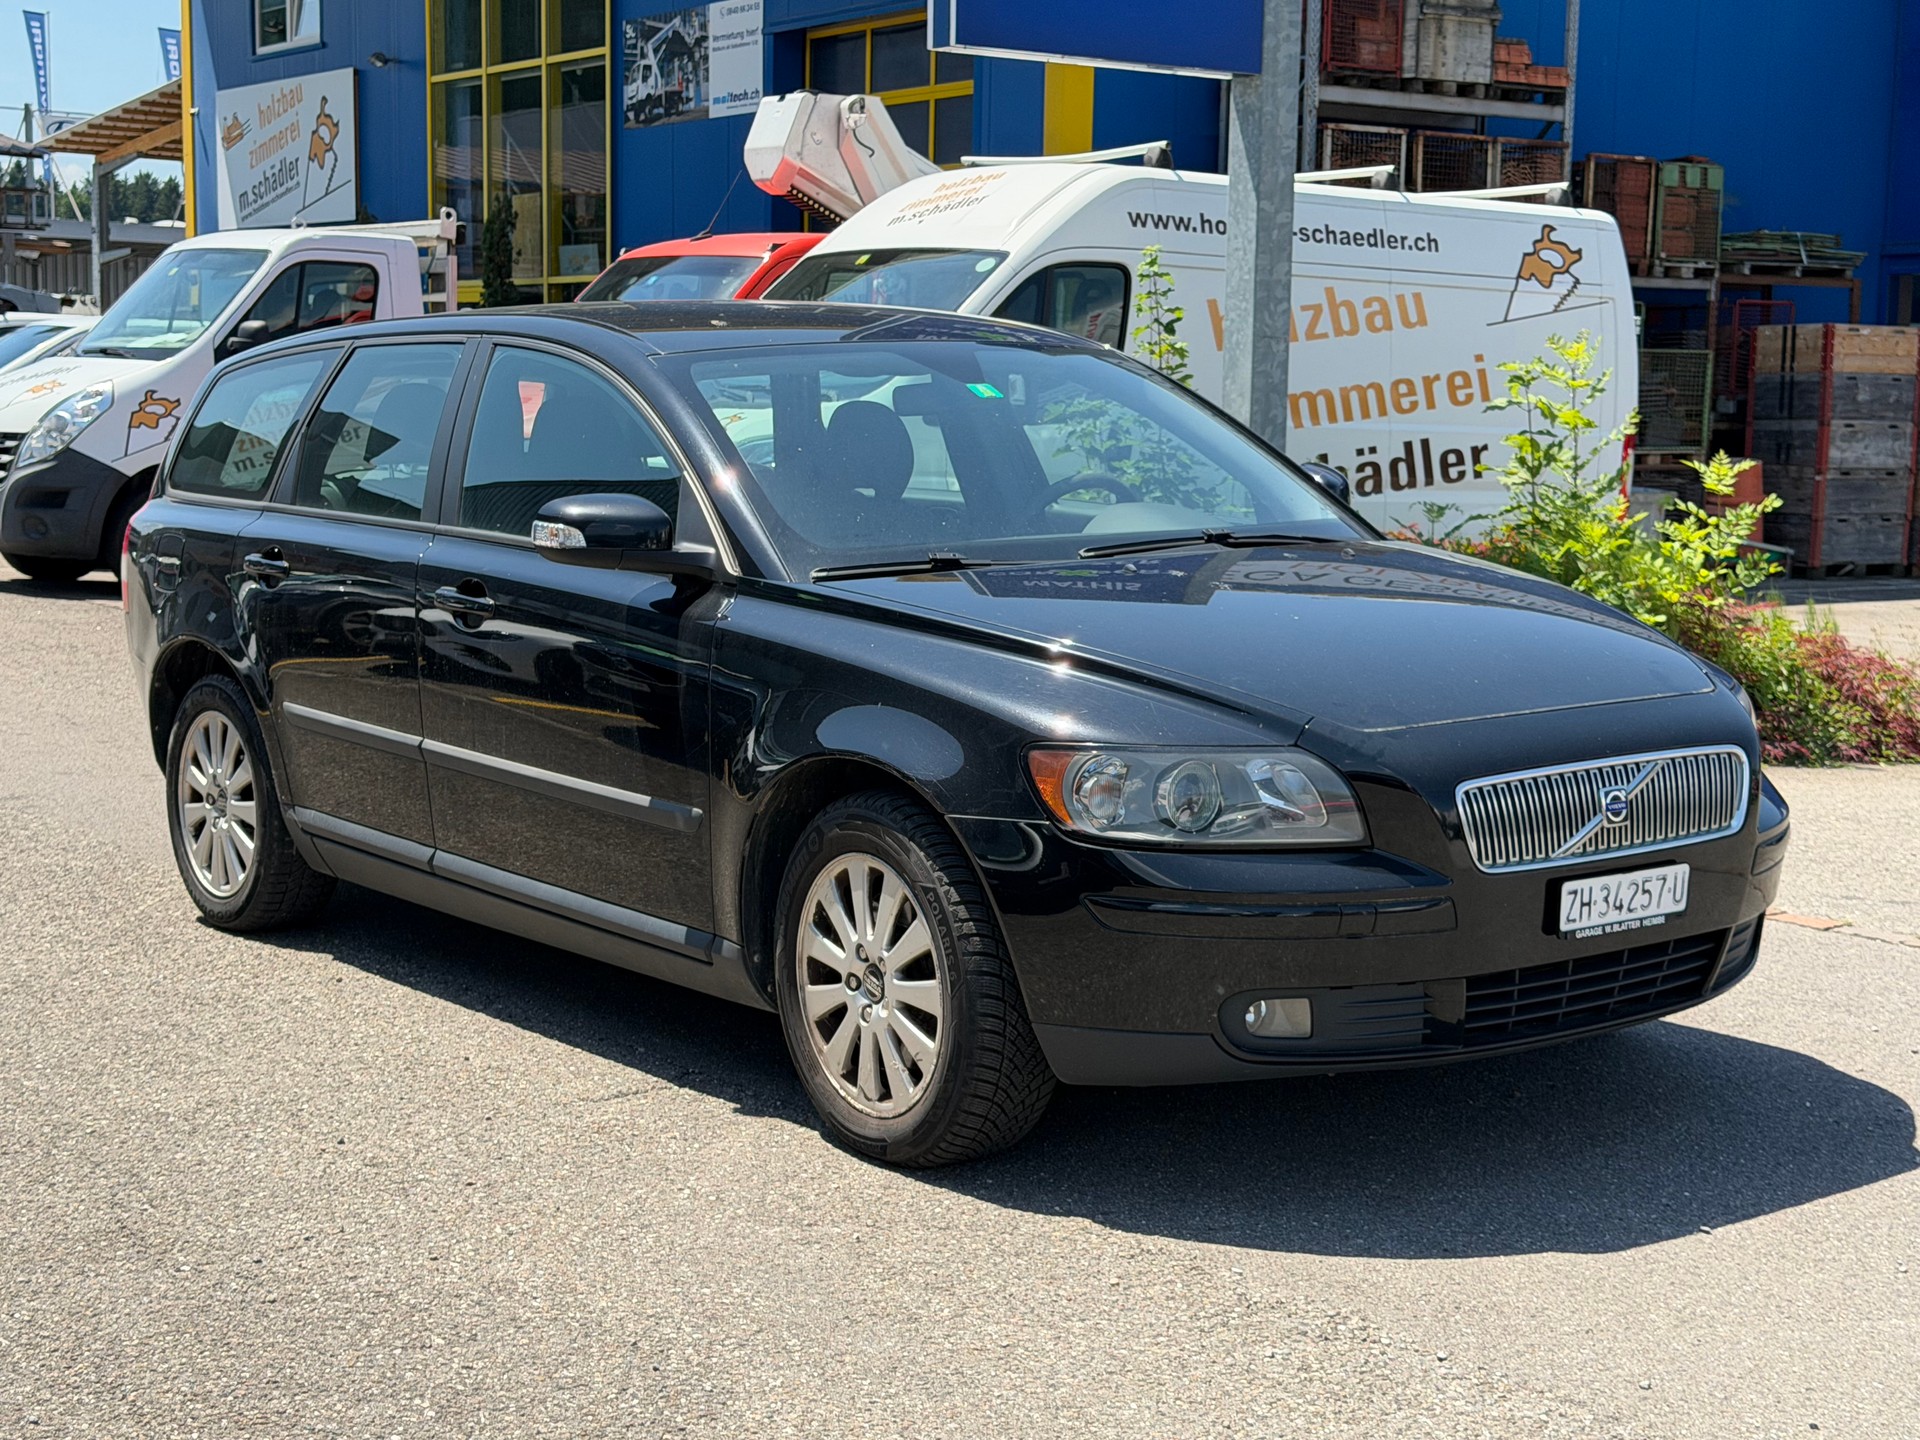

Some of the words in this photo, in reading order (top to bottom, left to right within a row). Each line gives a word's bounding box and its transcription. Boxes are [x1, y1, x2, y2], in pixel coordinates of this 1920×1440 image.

[257, 82, 304, 130] holzbau
[248, 111, 301, 170] zimmerei
[238, 156, 301, 213] m.schädler
[898, 182, 988, 213] zimmerei
[933, 171, 1007, 193] holzbau
[886, 194, 991, 227] m.schädler
[1287, 353, 1491, 430] mmerei
[1607, 802, 1627, 811] VOLVO
[925, 891, 956, 967] POLARIS
[1575, 926, 1604, 939] GARAGE
